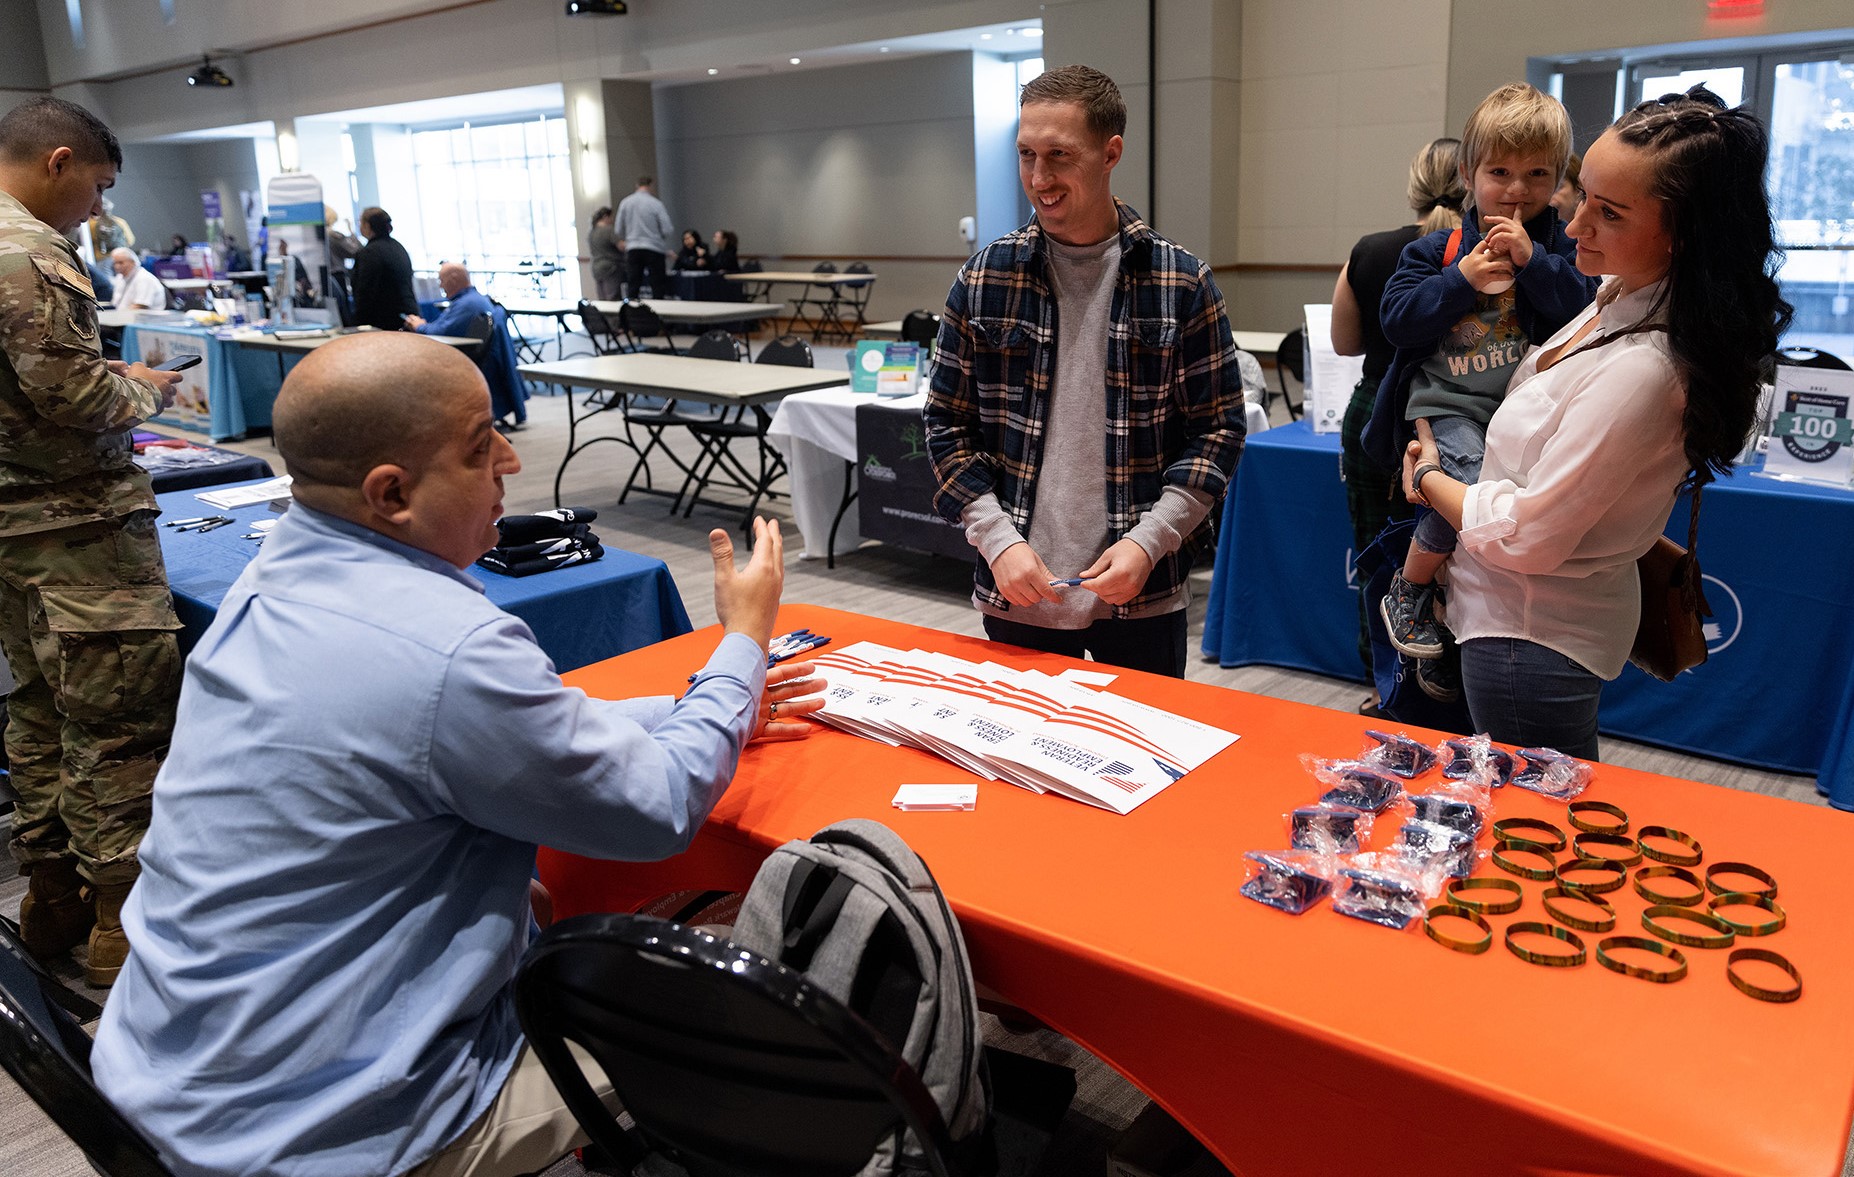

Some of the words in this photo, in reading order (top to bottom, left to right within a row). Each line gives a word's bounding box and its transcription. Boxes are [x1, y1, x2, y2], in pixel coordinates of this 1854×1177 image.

[1789, 416, 1837, 439] 100
[1787, 442, 1832, 460] EXPERIENCE
[1032, 736, 1104, 764] EMPLOYMENT
[1038, 743, 1097, 768] READINESS
[1040, 750, 1089, 772] VETERAN
